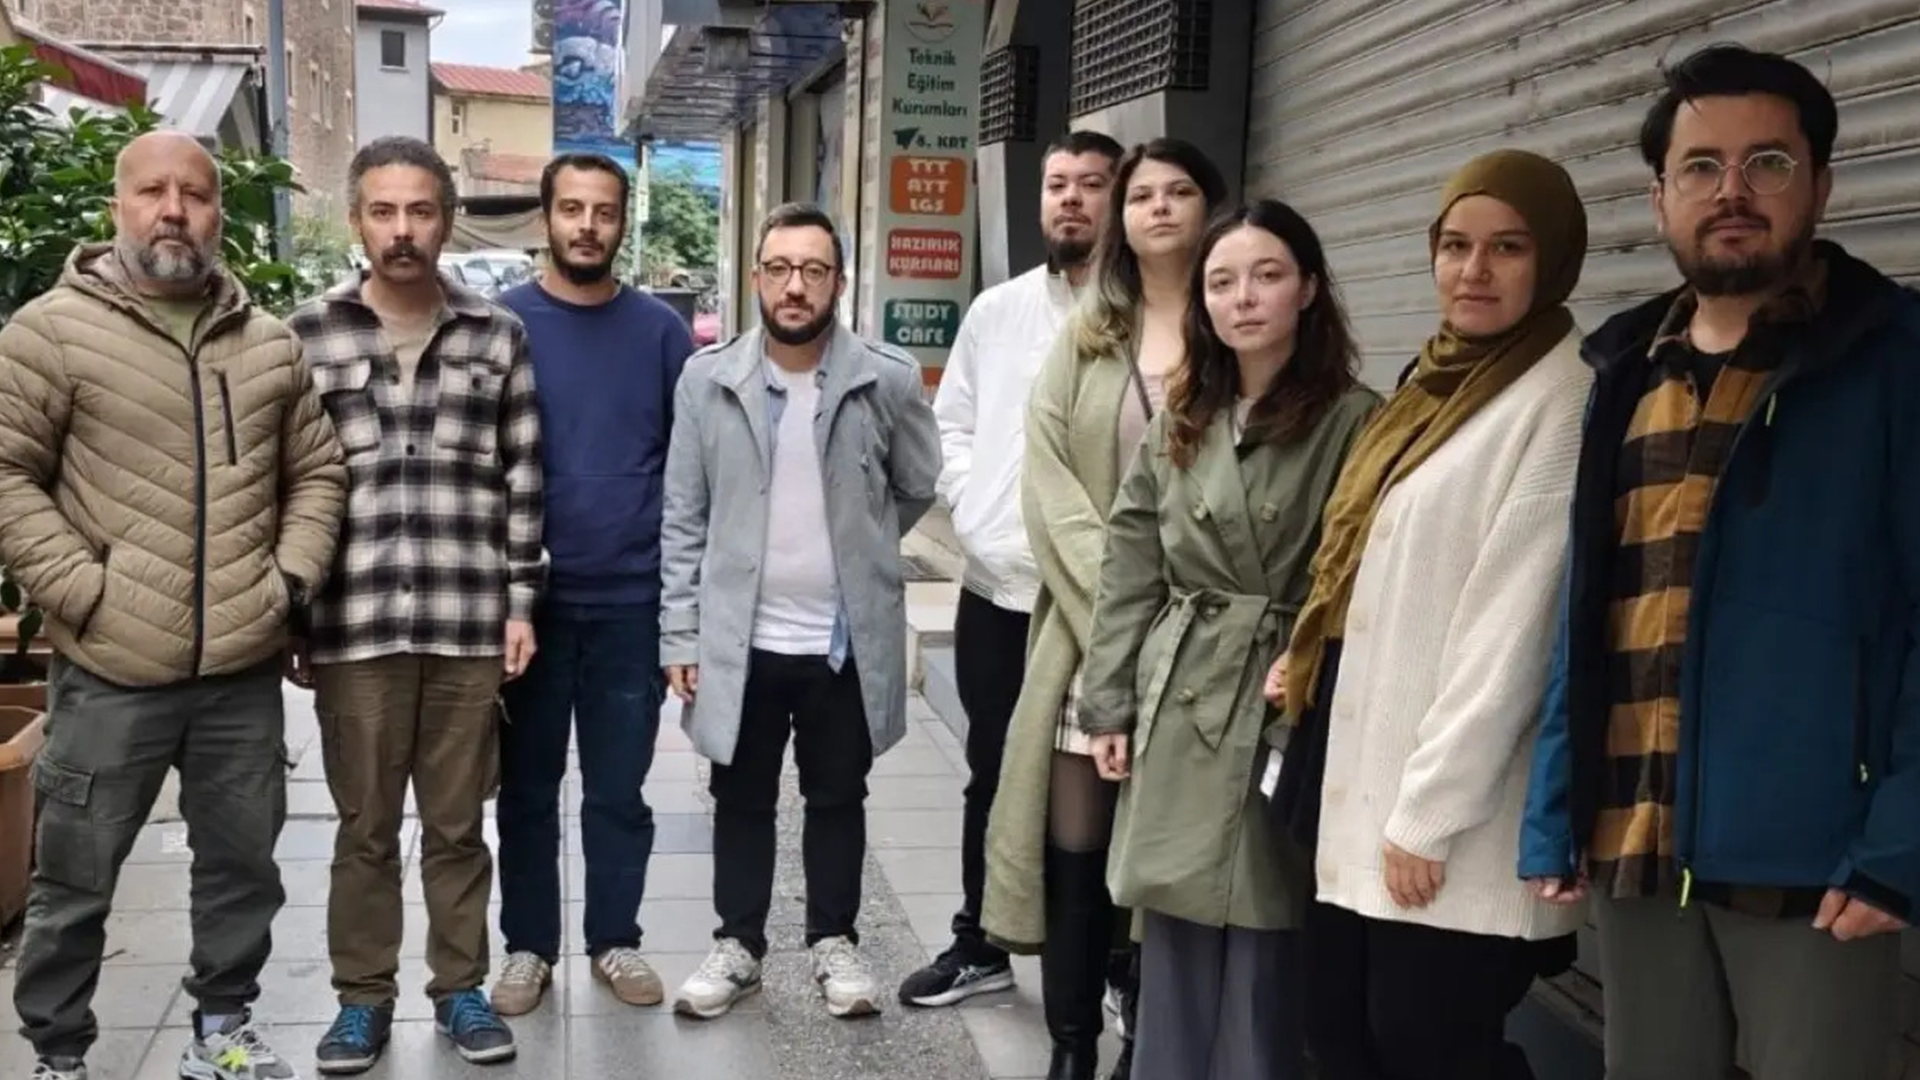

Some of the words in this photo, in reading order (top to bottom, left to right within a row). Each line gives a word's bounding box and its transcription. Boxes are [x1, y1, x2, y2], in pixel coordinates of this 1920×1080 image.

[908, 48, 956, 65] Teknik
[907, 73, 955, 93] Eğitim
[892, 98, 968, 117] Kurumları
[892, 303, 950, 319] STUDY
[896, 327, 944, 344] CAFE
